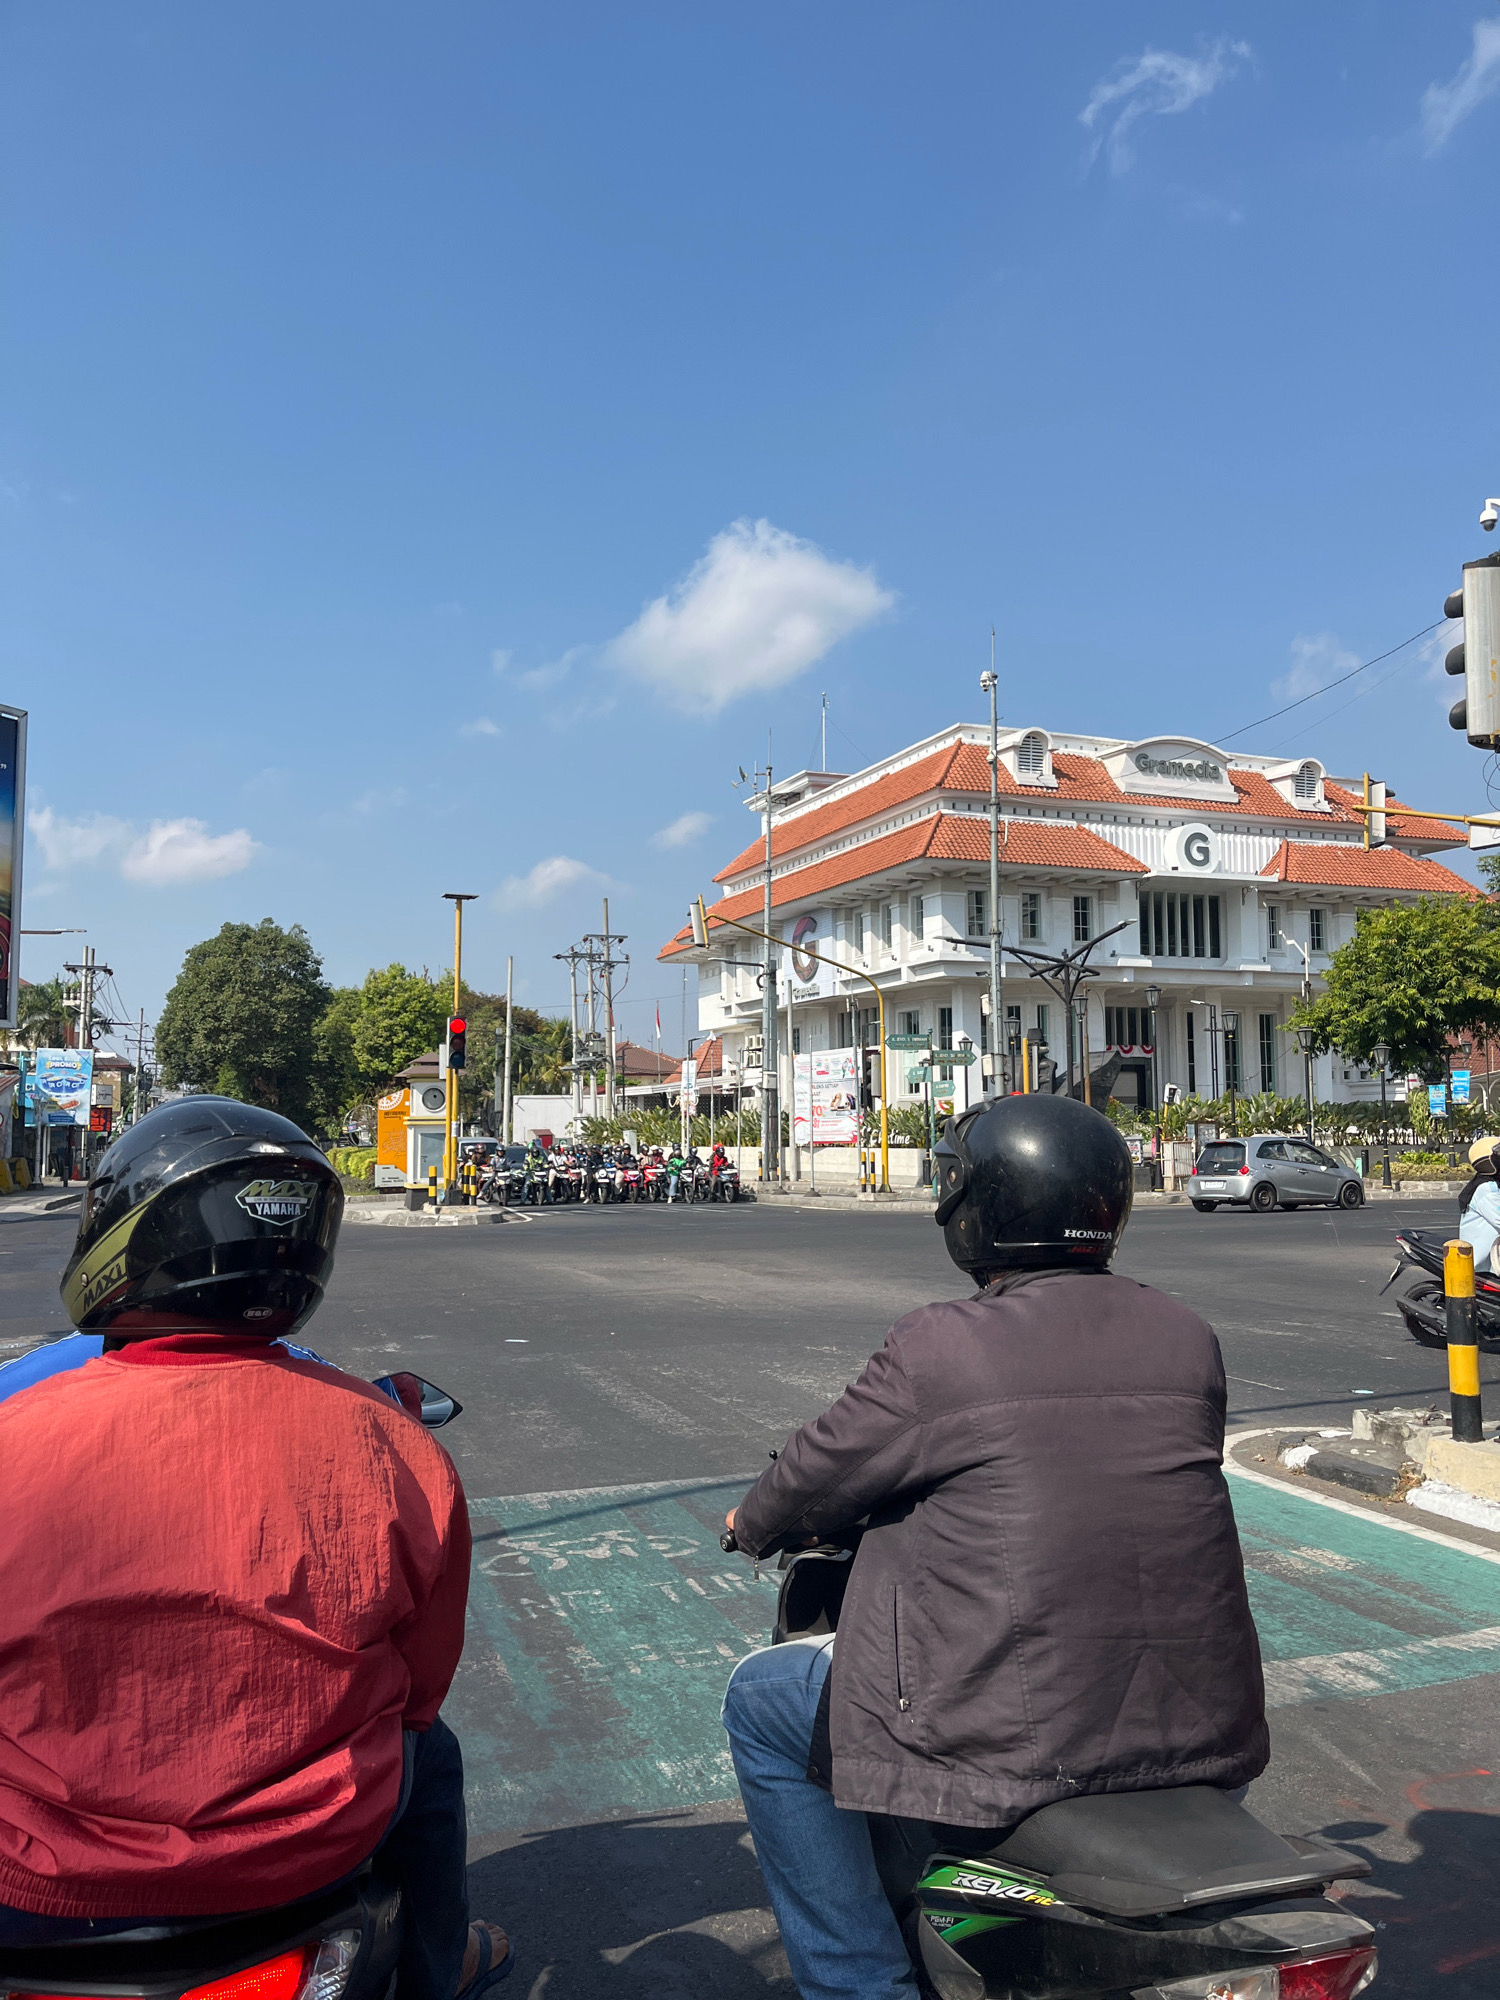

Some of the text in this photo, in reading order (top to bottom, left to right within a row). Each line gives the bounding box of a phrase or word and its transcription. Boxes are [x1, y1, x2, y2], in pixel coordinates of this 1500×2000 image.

[1135, 752, 1220, 780] Gramedia
[1184, 831, 1210, 867] G
[49, 1061, 78, 1069] PROMO
[870, 1127, 910, 1147] Ctime
[239, 1180, 317, 1198] MAXI
[255, 1203, 301, 1216] YAMAHA
[1063, 1229, 1113, 1240] HONDA
[82, 1263, 123, 1312] MAXI
[951, 1871, 1038, 1899] REVO
